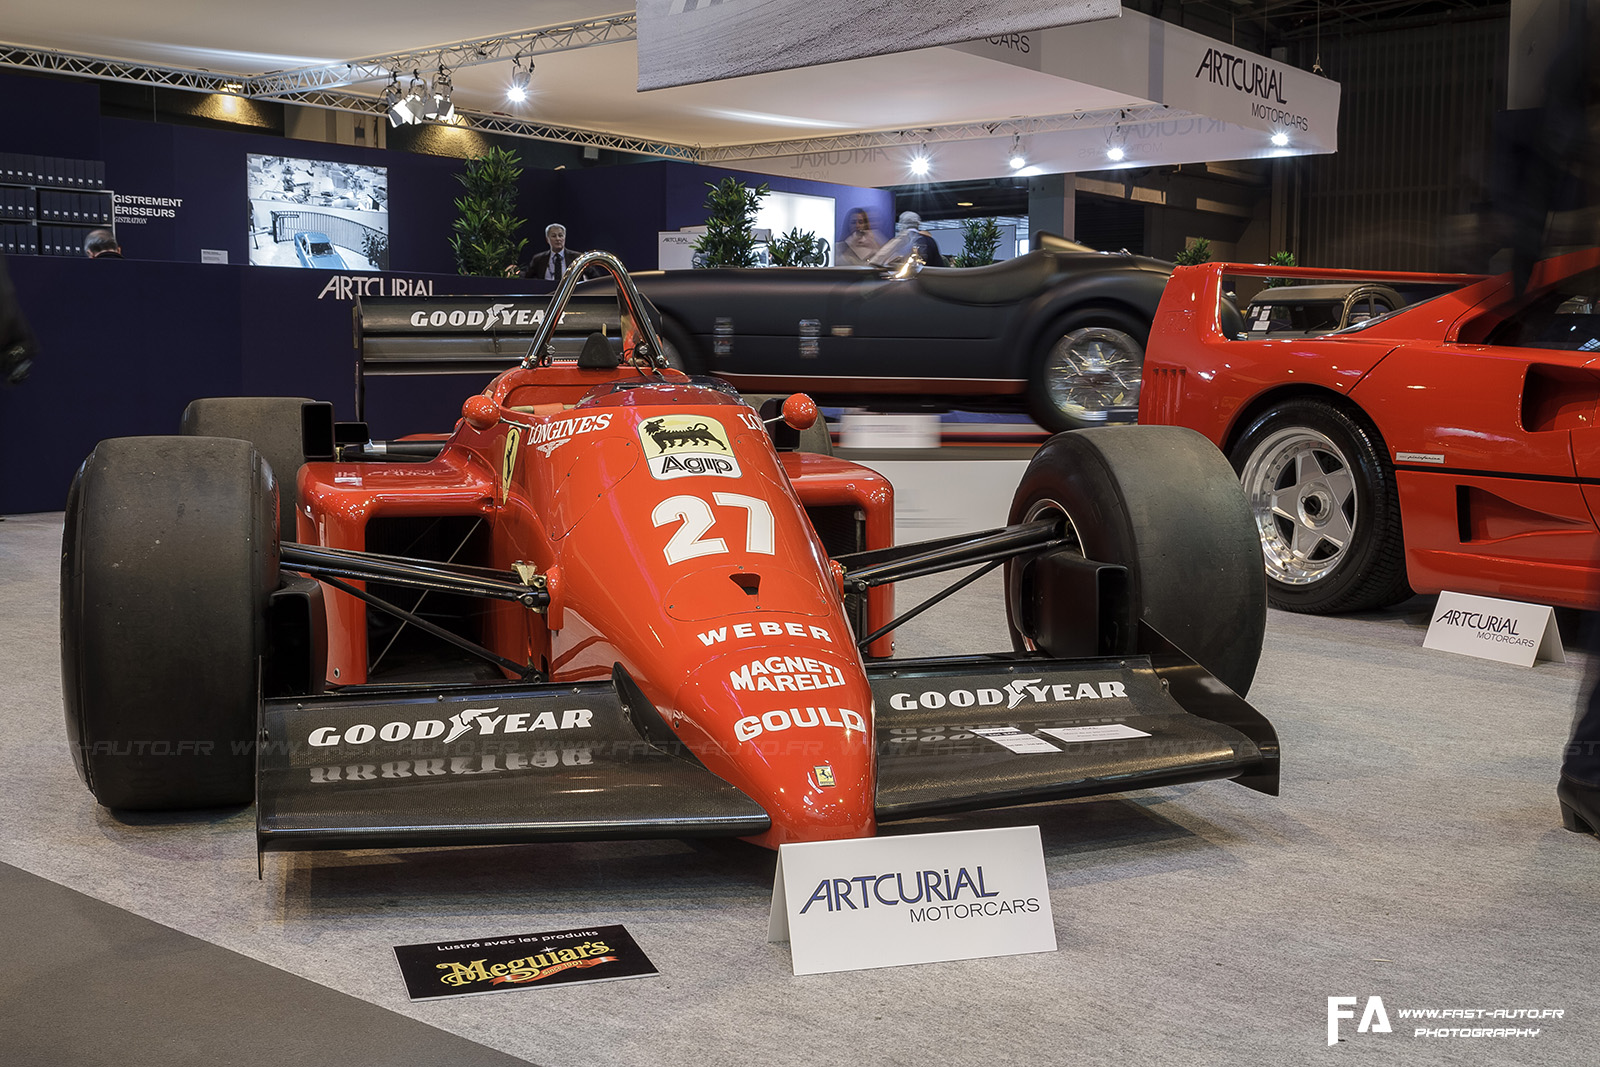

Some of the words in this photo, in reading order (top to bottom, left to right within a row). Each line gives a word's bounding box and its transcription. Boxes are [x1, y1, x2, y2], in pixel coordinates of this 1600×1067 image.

[1251, 103, 1308, 131] MOTORCARS
[527, 413, 613, 446] LONGINES
[660, 455, 733, 476] Agip
[651, 491, 776, 566] 27
[697, 622, 833, 647] WEBER
[1476, 631, 1535, 648] MOTORCARS
[729, 656, 844, 685] MAGNETI
[729, 670, 846, 692] MARELLI
[889, 678, 1129, 710] GOODYEAR
[308, 706, 594, 747] GOODYEAR
[734, 707, 867, 742] GOULD
[909, 897, 1040, 923] MOTORCARS
[437, 940, 480, 951] Lustré
[484, 938, 516, 947] avec
[519, 935, 539, 943] les
[542, 930, 599, 942] produits
[435, 941, 612, 987] Meguiar's
[542, 965, 562, 976] Since
[563, 960, 583, 969] 1901
